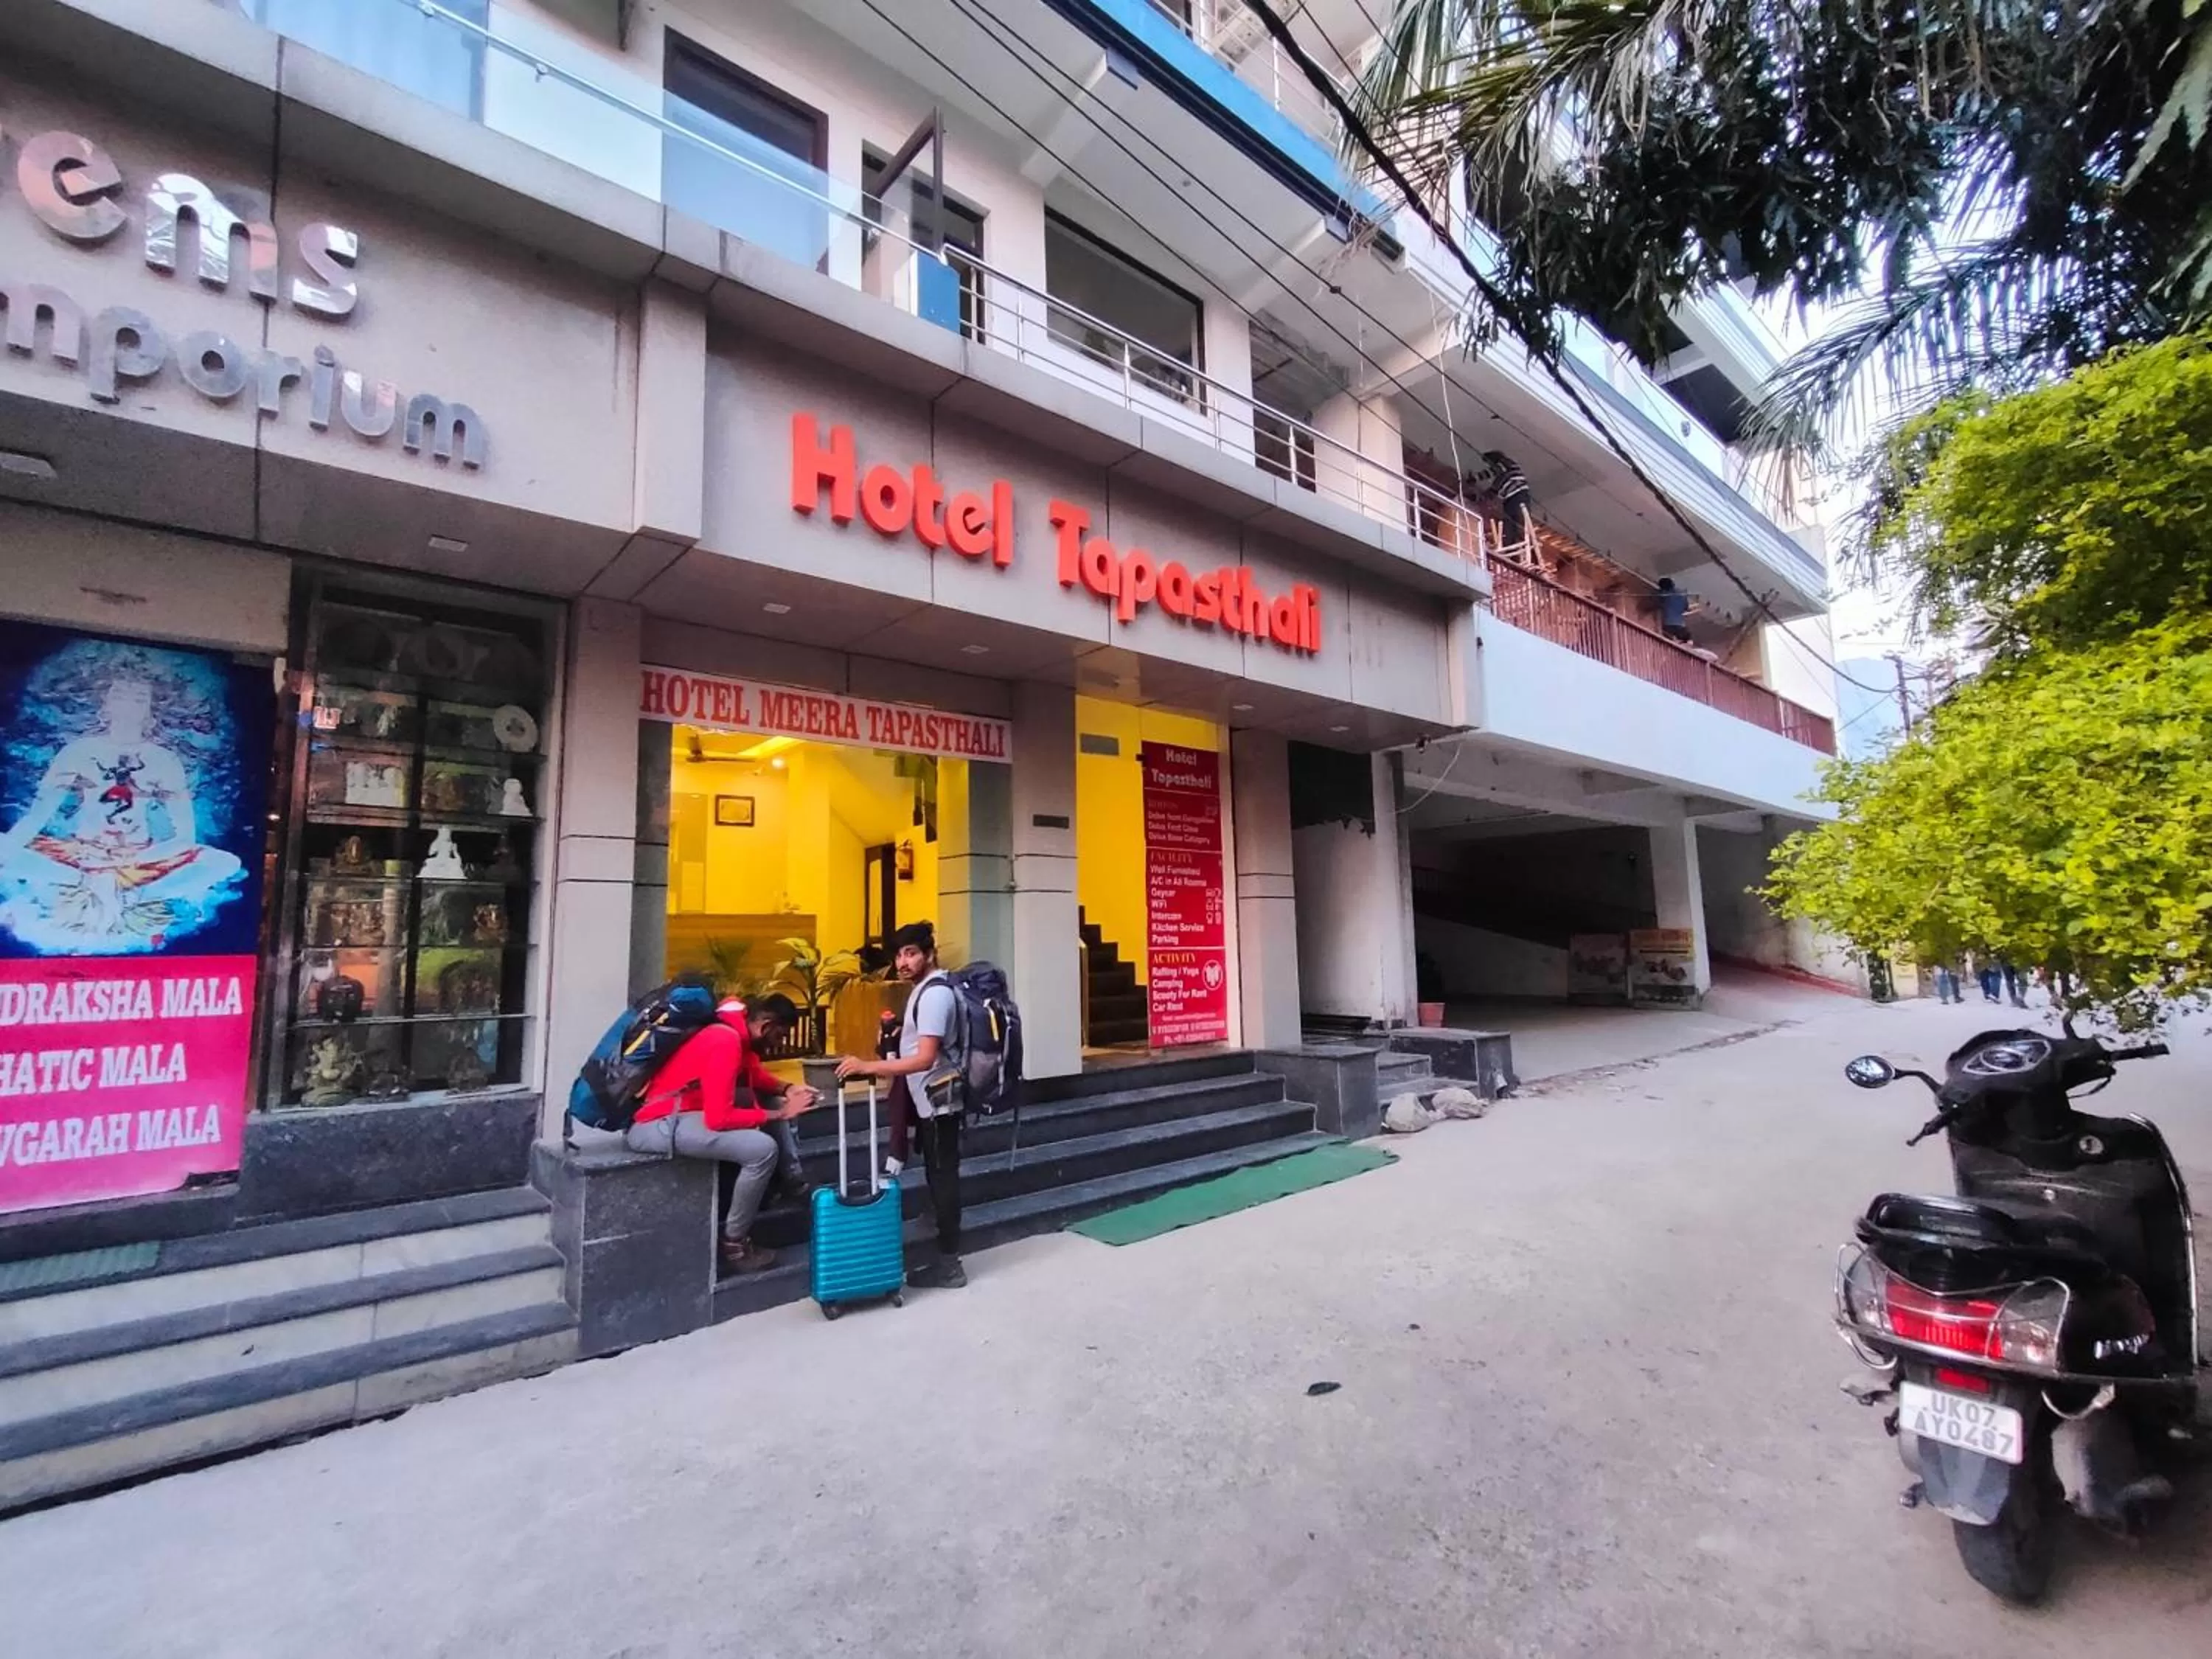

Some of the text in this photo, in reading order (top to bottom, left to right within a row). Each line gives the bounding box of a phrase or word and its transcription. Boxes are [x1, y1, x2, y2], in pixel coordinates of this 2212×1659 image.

[0, 125, 359, 322] ems
[791, 412, 1321, 654] Hotel Tapasthali
[639, 669, 1006, 757] HOTEL MEERA TAPASTHALI
[1166, 748, 1197, 766] Hotel
[0, 976, 243, 1026] DRAKSHA MALA
[99, 1043, 187, 1088] MALA
[136, 1105, 221, 1152] MALA
[1931, 1391, 1997, 1427] UK07
